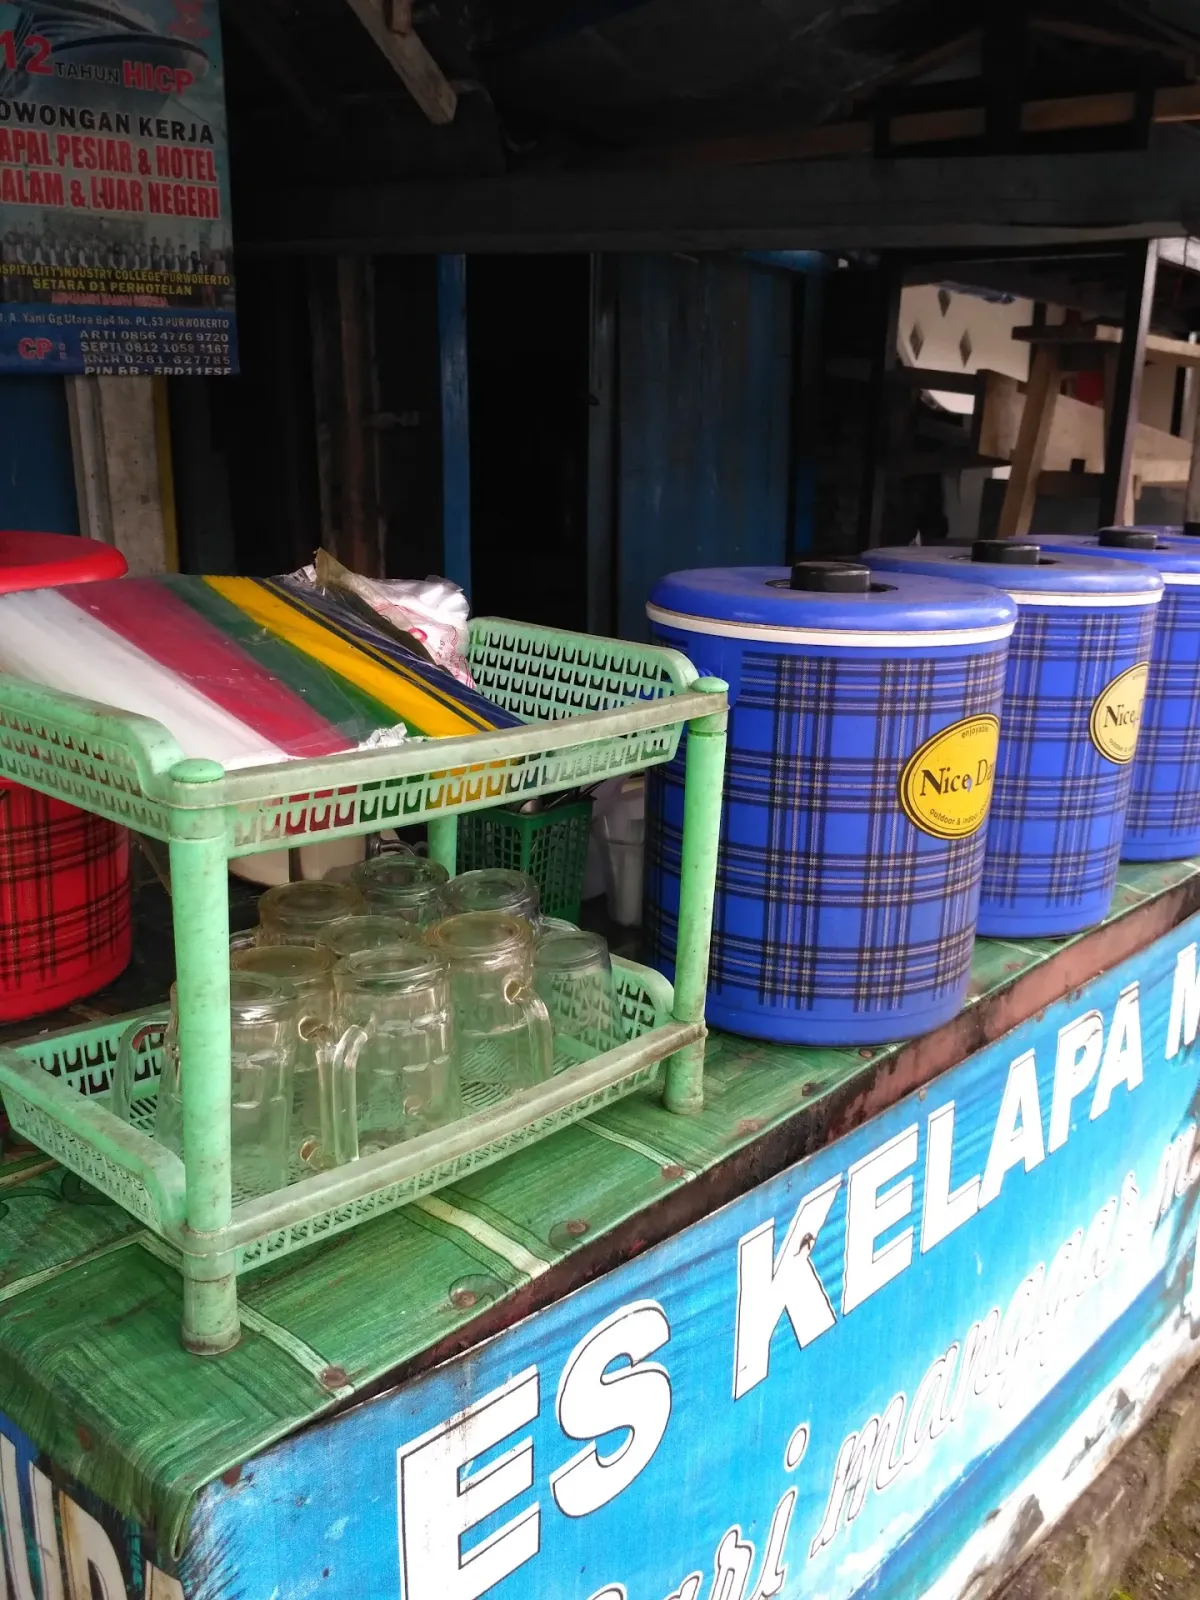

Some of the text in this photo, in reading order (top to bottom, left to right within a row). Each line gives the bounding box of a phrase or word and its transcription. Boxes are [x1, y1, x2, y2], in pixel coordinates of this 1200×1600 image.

[0, 31, 195, 95] 12 TAHUN HICP
[139, 116, 214, 145] KERJA
[57, 134, 132, 174] PESIAR
[138, 148, 152, 176] &
[156, 145, 217, 183] HOTEL
[70, 179, 86, 208] &
[91, 176, 144, 213] LUAR
[148, 182, 219, 219] NEGERI
[32, 278, 86, 292] SETARA
[110, 282, 192, 296] PERHOTELAN
[162, 273, 231, 286] PURWOKERTO
[165, 317, 230, 329] PURWOKERTO
[80, 330, 229, 343] ARTI 0856 4776 9720
[80, 341, 121, 353] SEPTI
[125, 342, 159, 353] 0812
[18, 337, 53, 361] CP
[84, 366, 113, 376] PIN
[1103, 703, 1136, 729] Nice
[919, 766, 970, 797] Nice
[929, 807, 956, 826] outdoor
[397, 1299, 673, 1600] ES
[733, 980, 1145, 1400] KELAPA
